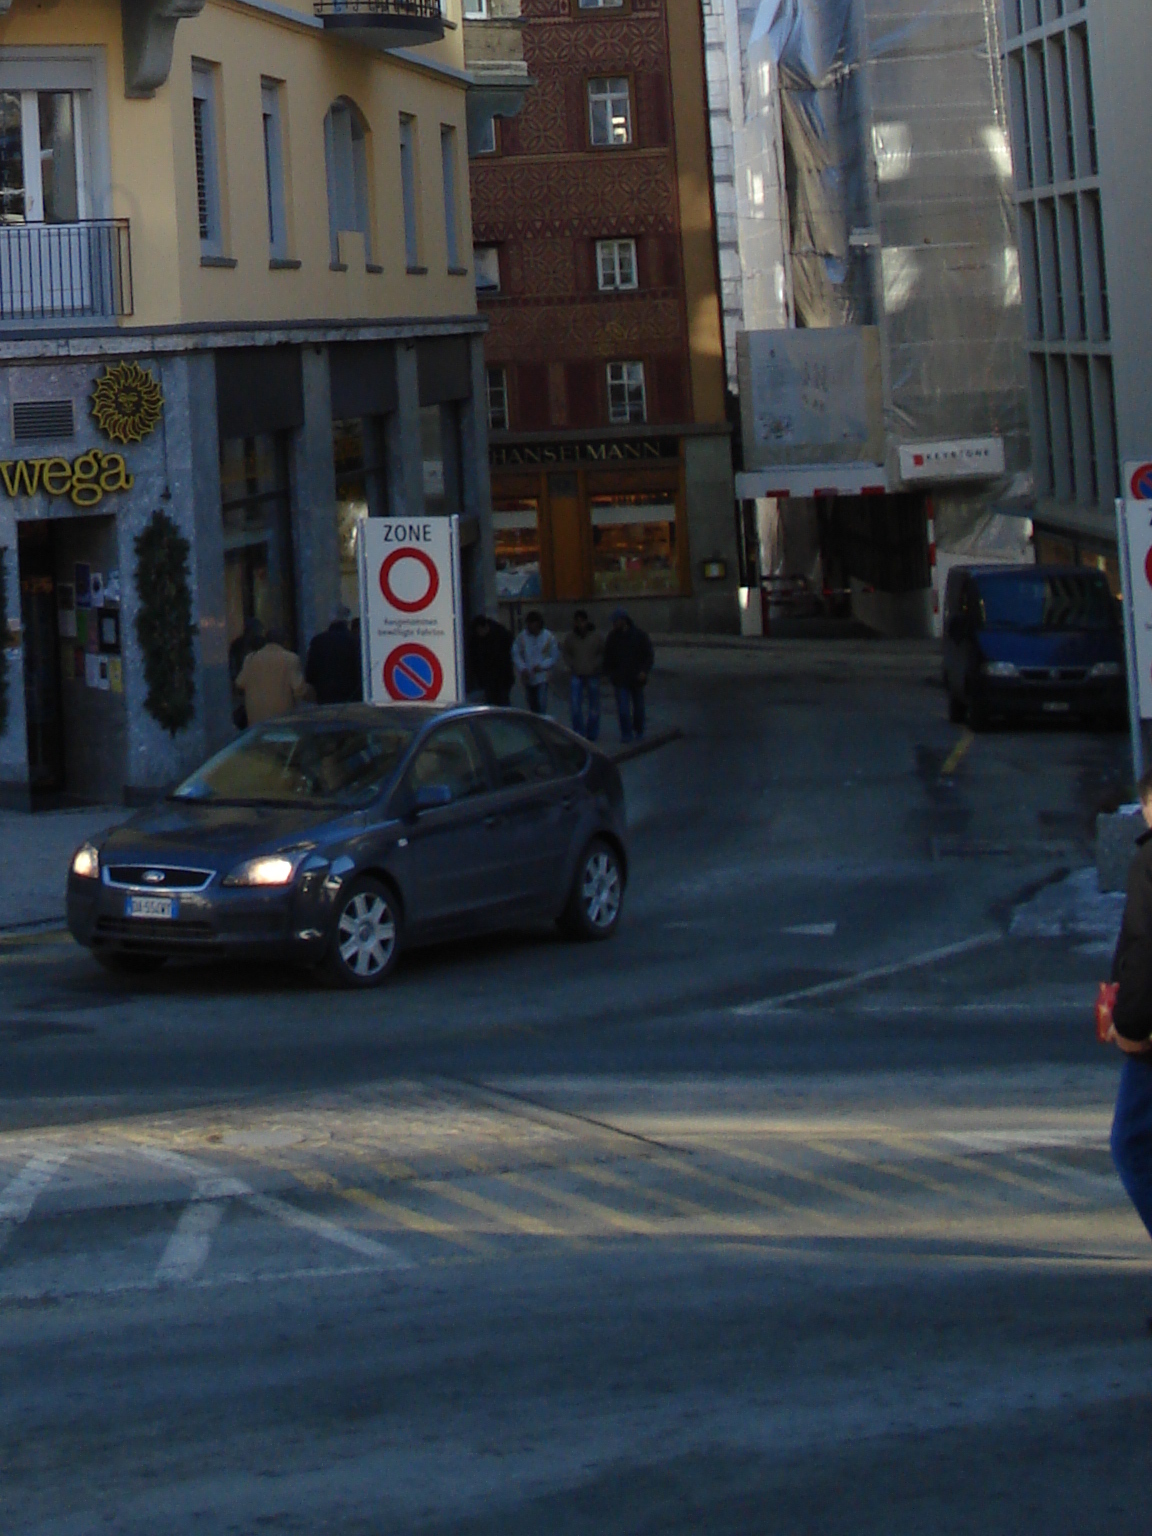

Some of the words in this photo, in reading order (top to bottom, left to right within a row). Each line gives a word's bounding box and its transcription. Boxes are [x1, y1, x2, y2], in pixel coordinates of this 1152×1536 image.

[491, 442, 660, 465] HANSELMANN
[926, 449, 989, 460] KEYSTONE
[383, 524, 432, 542] ZONE
